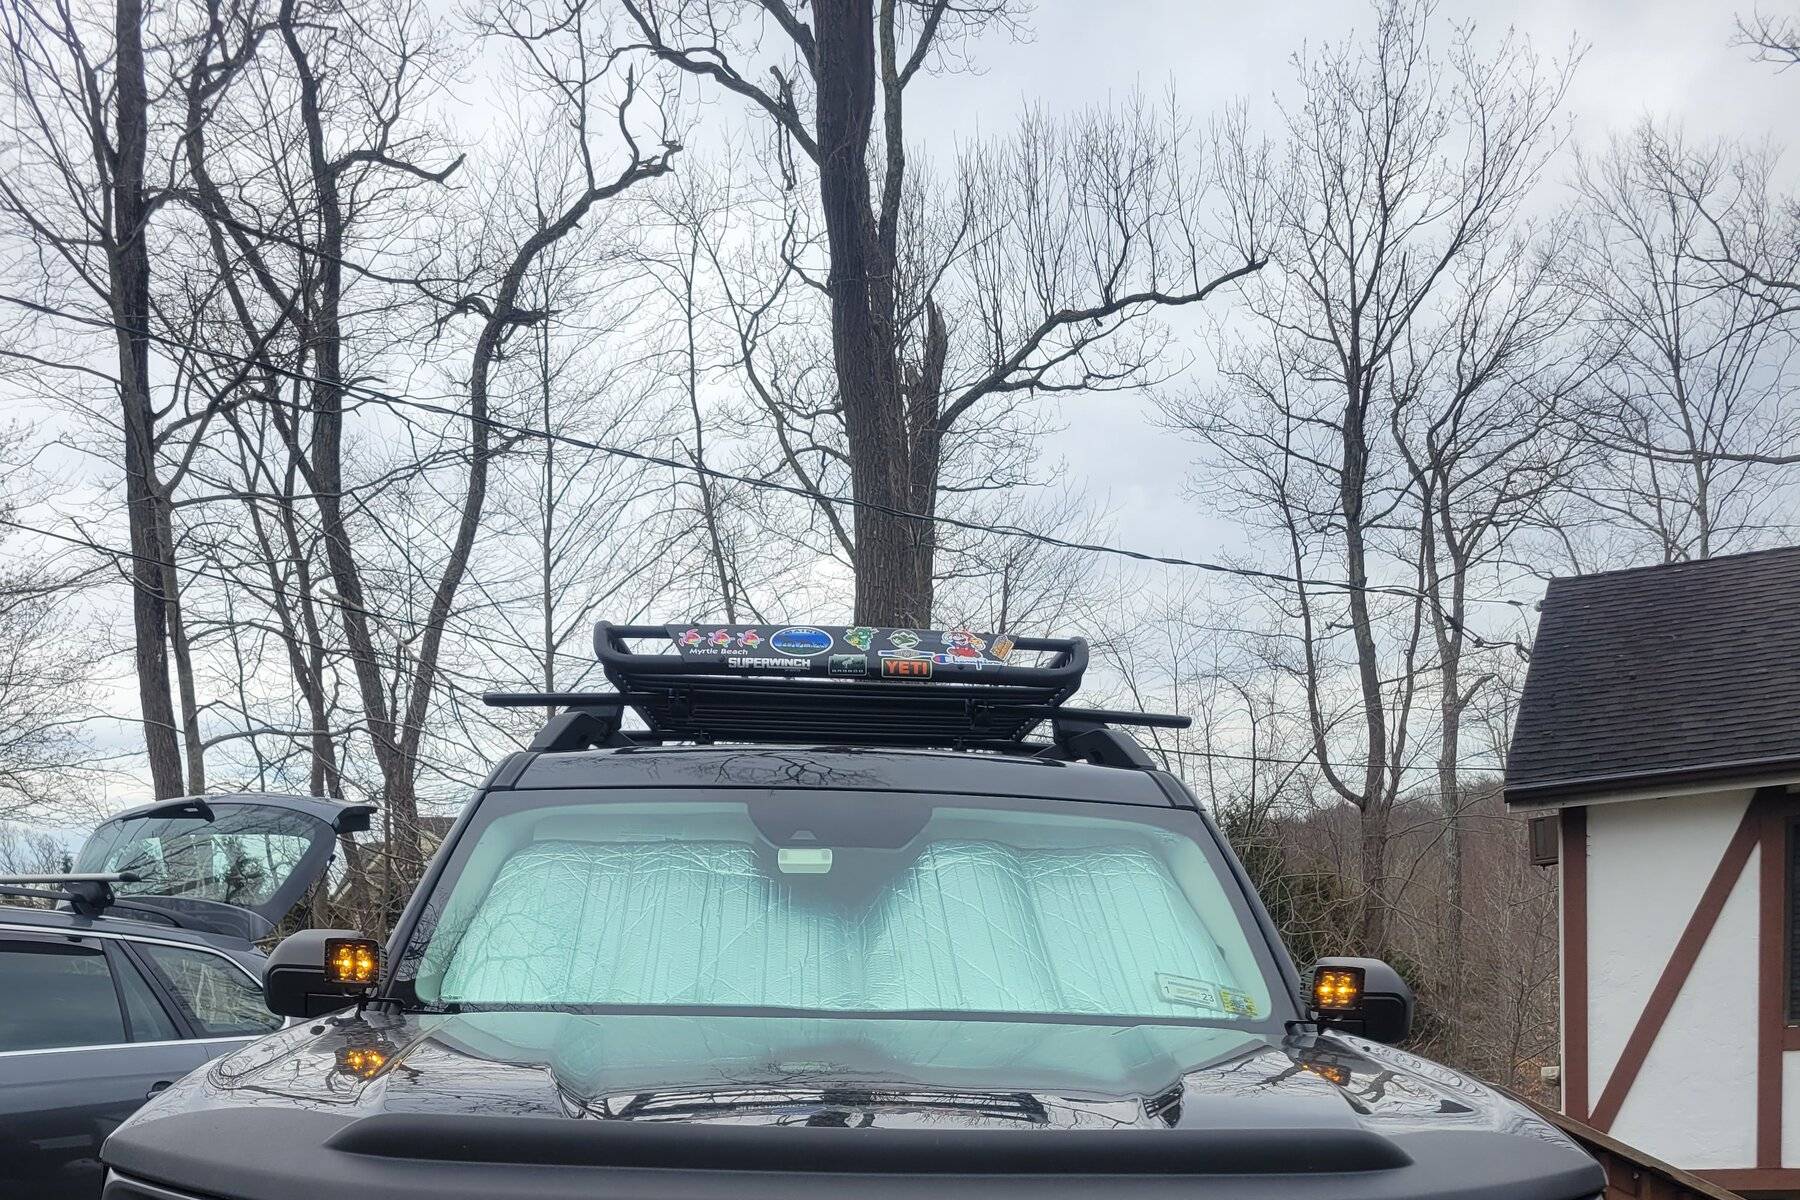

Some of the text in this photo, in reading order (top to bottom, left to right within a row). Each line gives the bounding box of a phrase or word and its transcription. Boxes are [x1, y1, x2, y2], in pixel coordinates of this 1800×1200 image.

[689, 648, 749, 656] Myrtle Beach
[728, 657, 811, 670] SUPERWINCH
[884, 660, 928, 676] YETI
[1200, 992, 1215, 1003] 23
